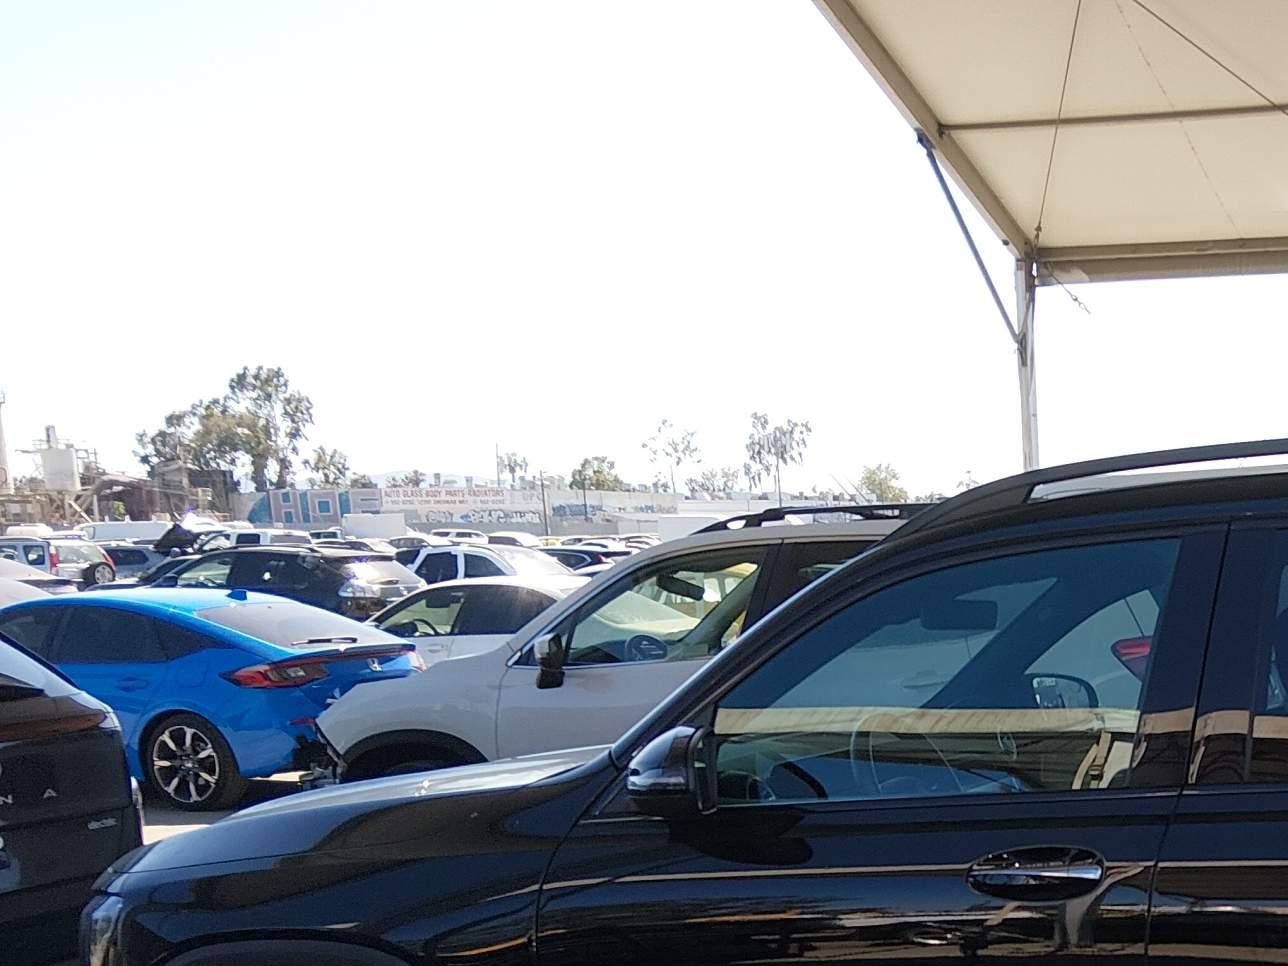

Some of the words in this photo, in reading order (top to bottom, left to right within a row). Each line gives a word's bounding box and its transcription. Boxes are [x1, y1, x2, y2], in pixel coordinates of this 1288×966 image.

[402, 489, 423, 498] GLASS
[425, 489, 441, 498] BODY
[467, 488, 505, 498] RADIATORS
